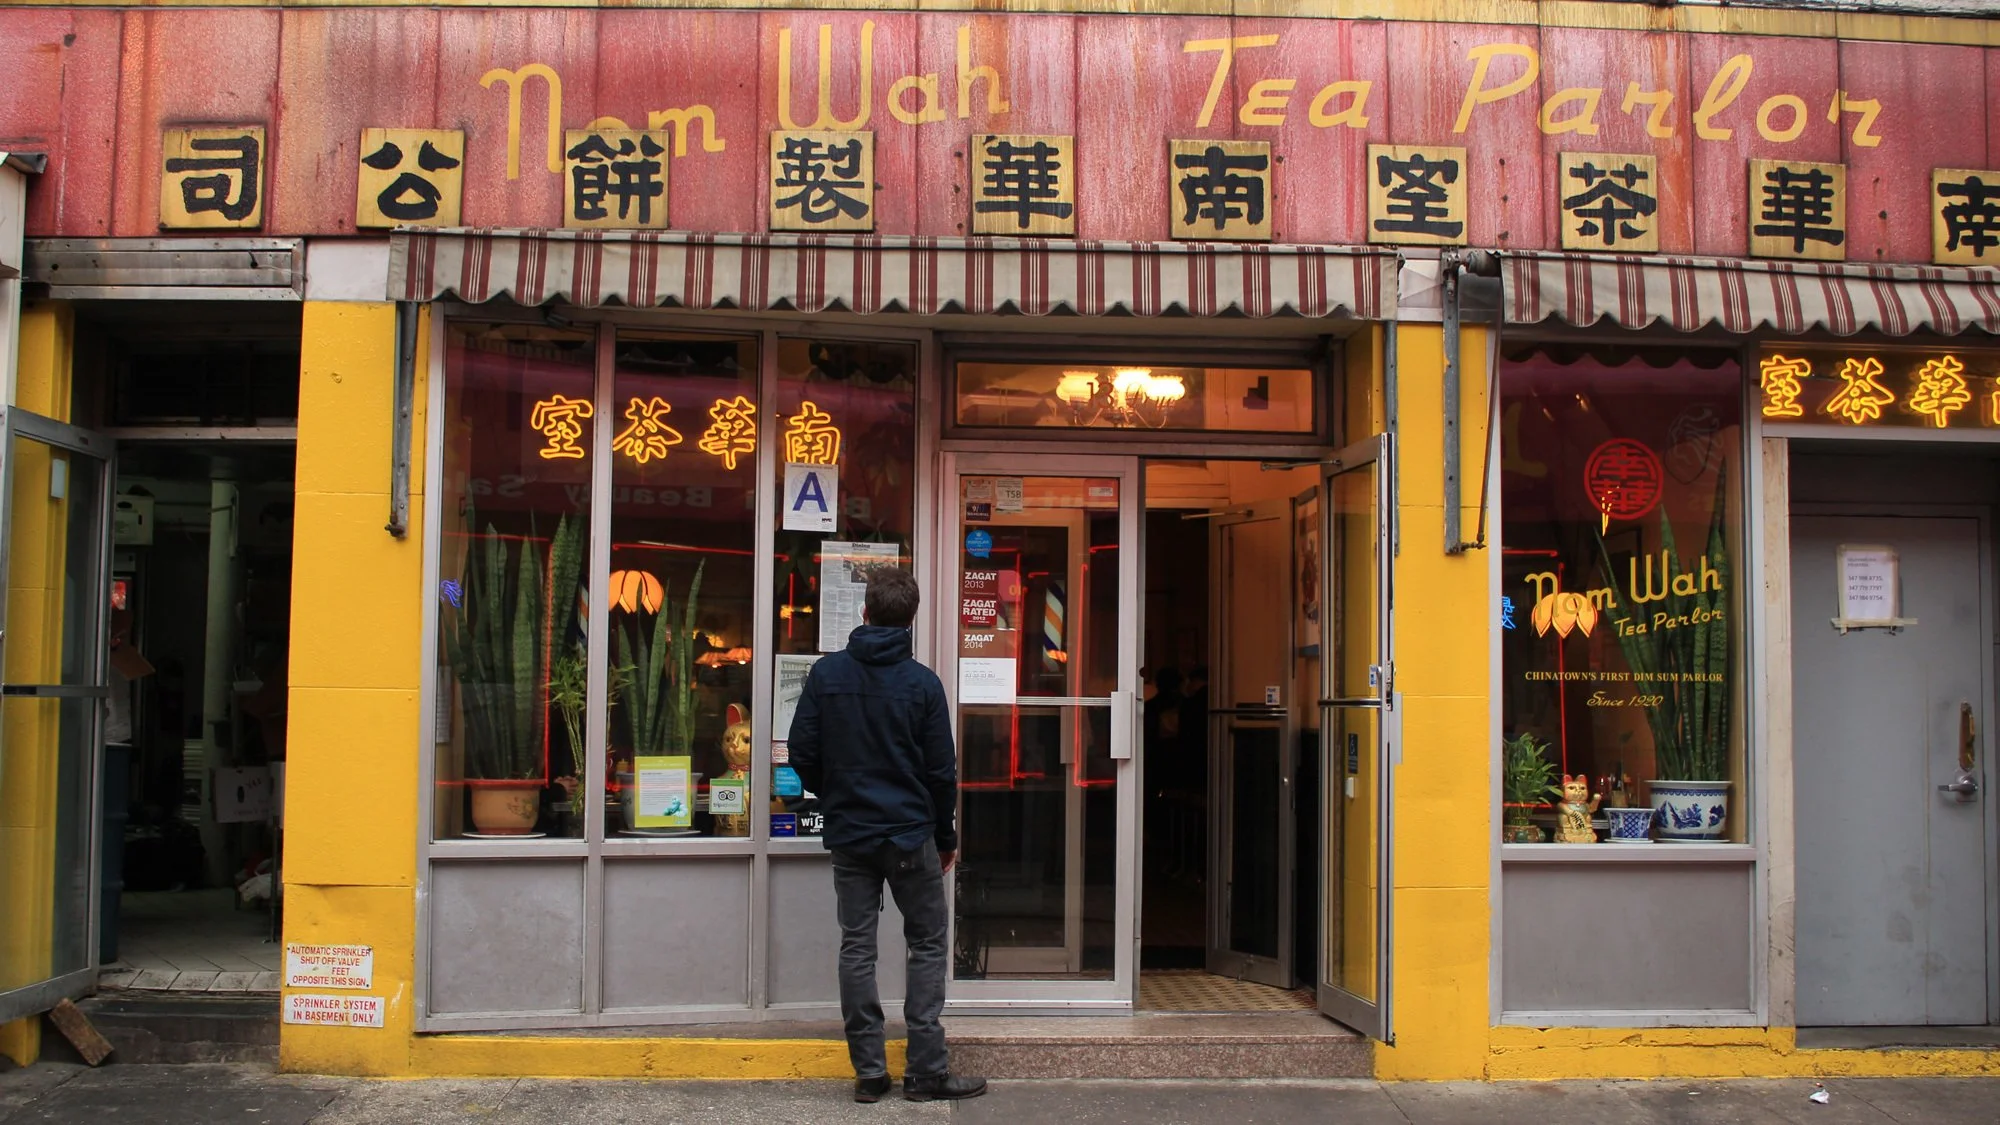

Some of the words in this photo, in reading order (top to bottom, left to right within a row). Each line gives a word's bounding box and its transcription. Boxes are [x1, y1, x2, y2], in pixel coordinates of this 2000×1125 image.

[480, 63, 726, 181] Nm
[778, 20, 1010, 131] Wah
[1184, 34, 1373, 129] Tea
[1453, 43, 1882, 147] Parlor
[792, 472, 828, 513] A
[964, 571, 997, 581] ZAGAT
[964, 580, 985, 589] 2013
[1524, 571, 1617, 621] Nom
[1630, 549, 1722, 604] Wah
[963, 599, 997, 608] ZAGAT
[963, 607, 997, 616] RATED
[1614, 616, 1648, 638] Tea
[1653, 608, 1724, 631] Parlor
[964, 634, 995, 642] ZAGAT
[964, 641, 984, 649] 2014
[1525, 671, 1597, 681] CHINATOWN'S
[1600, 672, 1630, 682] FIRST
[1634, 672, 1655, 682] DIM
[1657, 673, 1679, 682] SUM
[1682, 672, 1724, 682] PARLOR
[1587, 690, 1625, 708] Since
[1627, 695, 1664, 708] 1920
[291, 946, 331, 955] AUTOMATIC
[332, 947, 370, 957] SPRINKLER
[300, 956, 320, 965] SHUT
[322, 957, 336, 965] OFF
[337, 957, 360, 966] VALVE
[332, 967, 350, 976] FEET
[292, 975, 329, 985] OPPOSITE
[331, 977, 347, 985] THIS
[293, 998, 340, 1009] SPRINKLER
[343, 999, 377, 1011] SYSTEM
[293, 1011, 302, 1020] IN
[305, 1011, 350, 1022] BASEMENT
